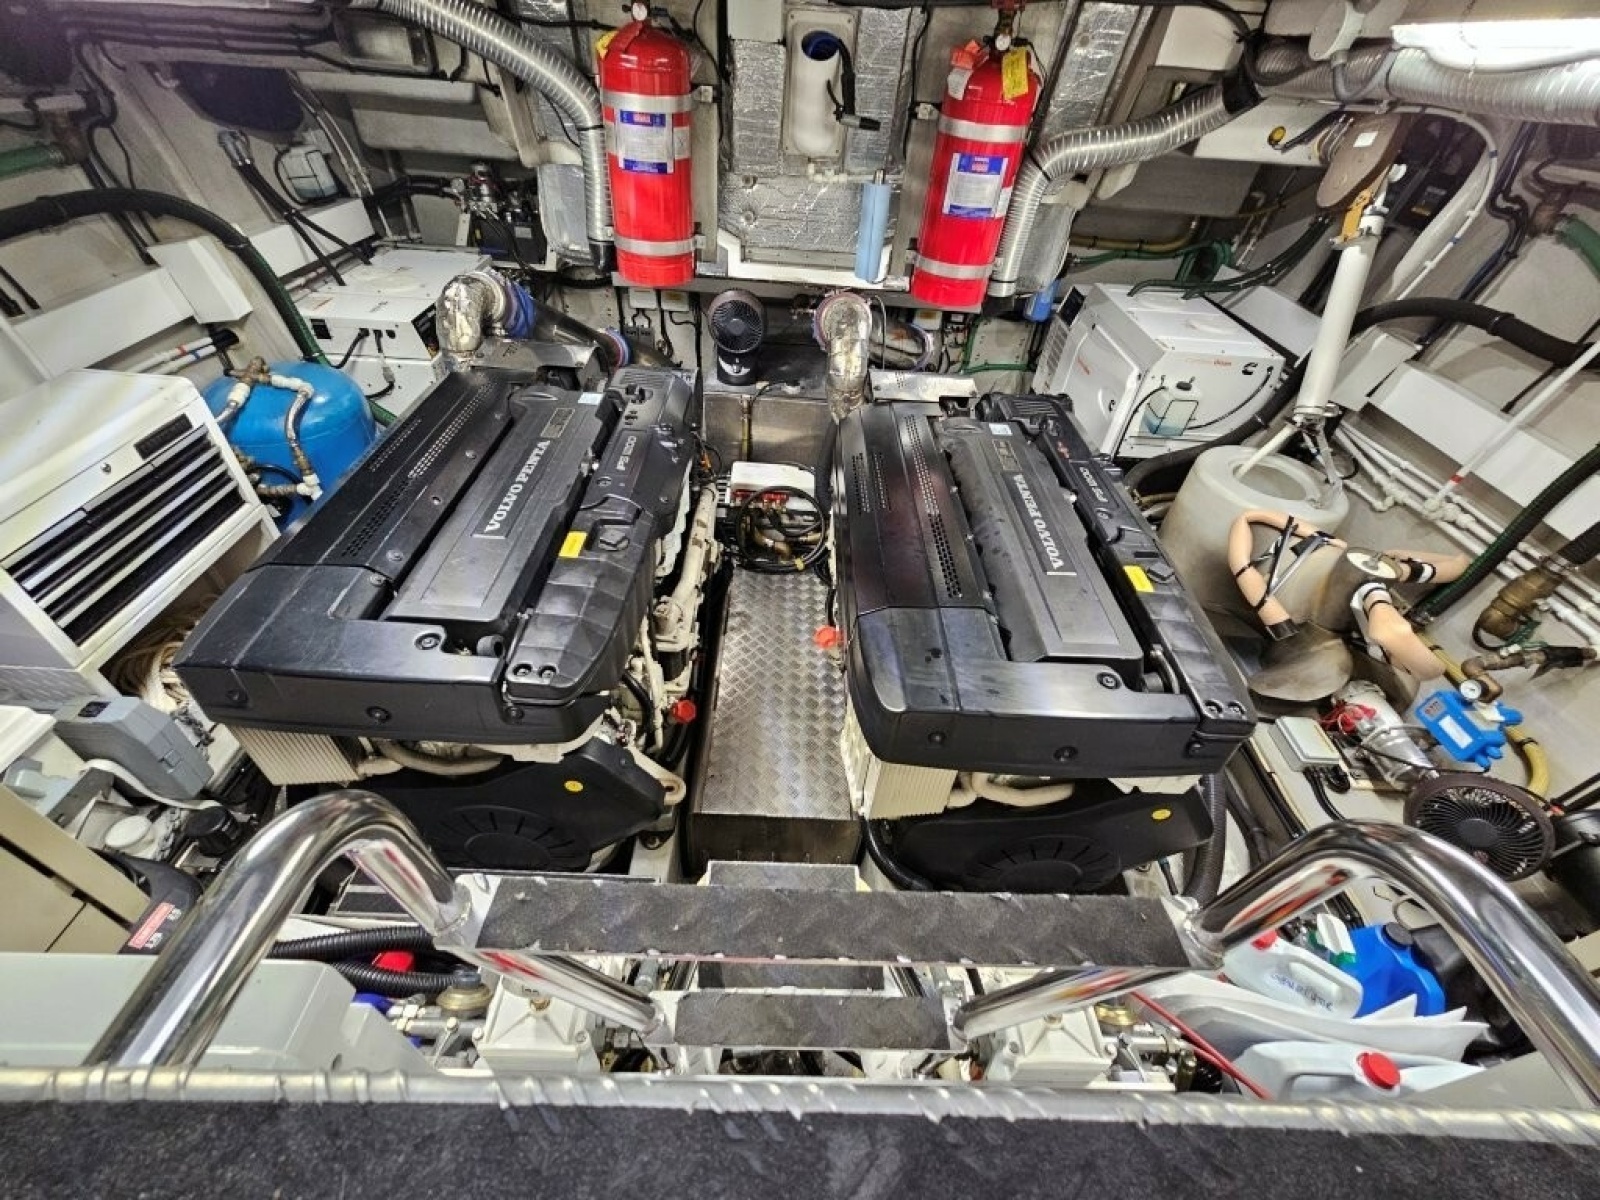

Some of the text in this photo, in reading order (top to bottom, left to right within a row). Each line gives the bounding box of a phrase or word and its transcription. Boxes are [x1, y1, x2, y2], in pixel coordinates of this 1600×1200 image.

[483, 440, 551, 533] VOLVO PENTA
[1013, 474, 1065, 570] VOLVO PENTA
